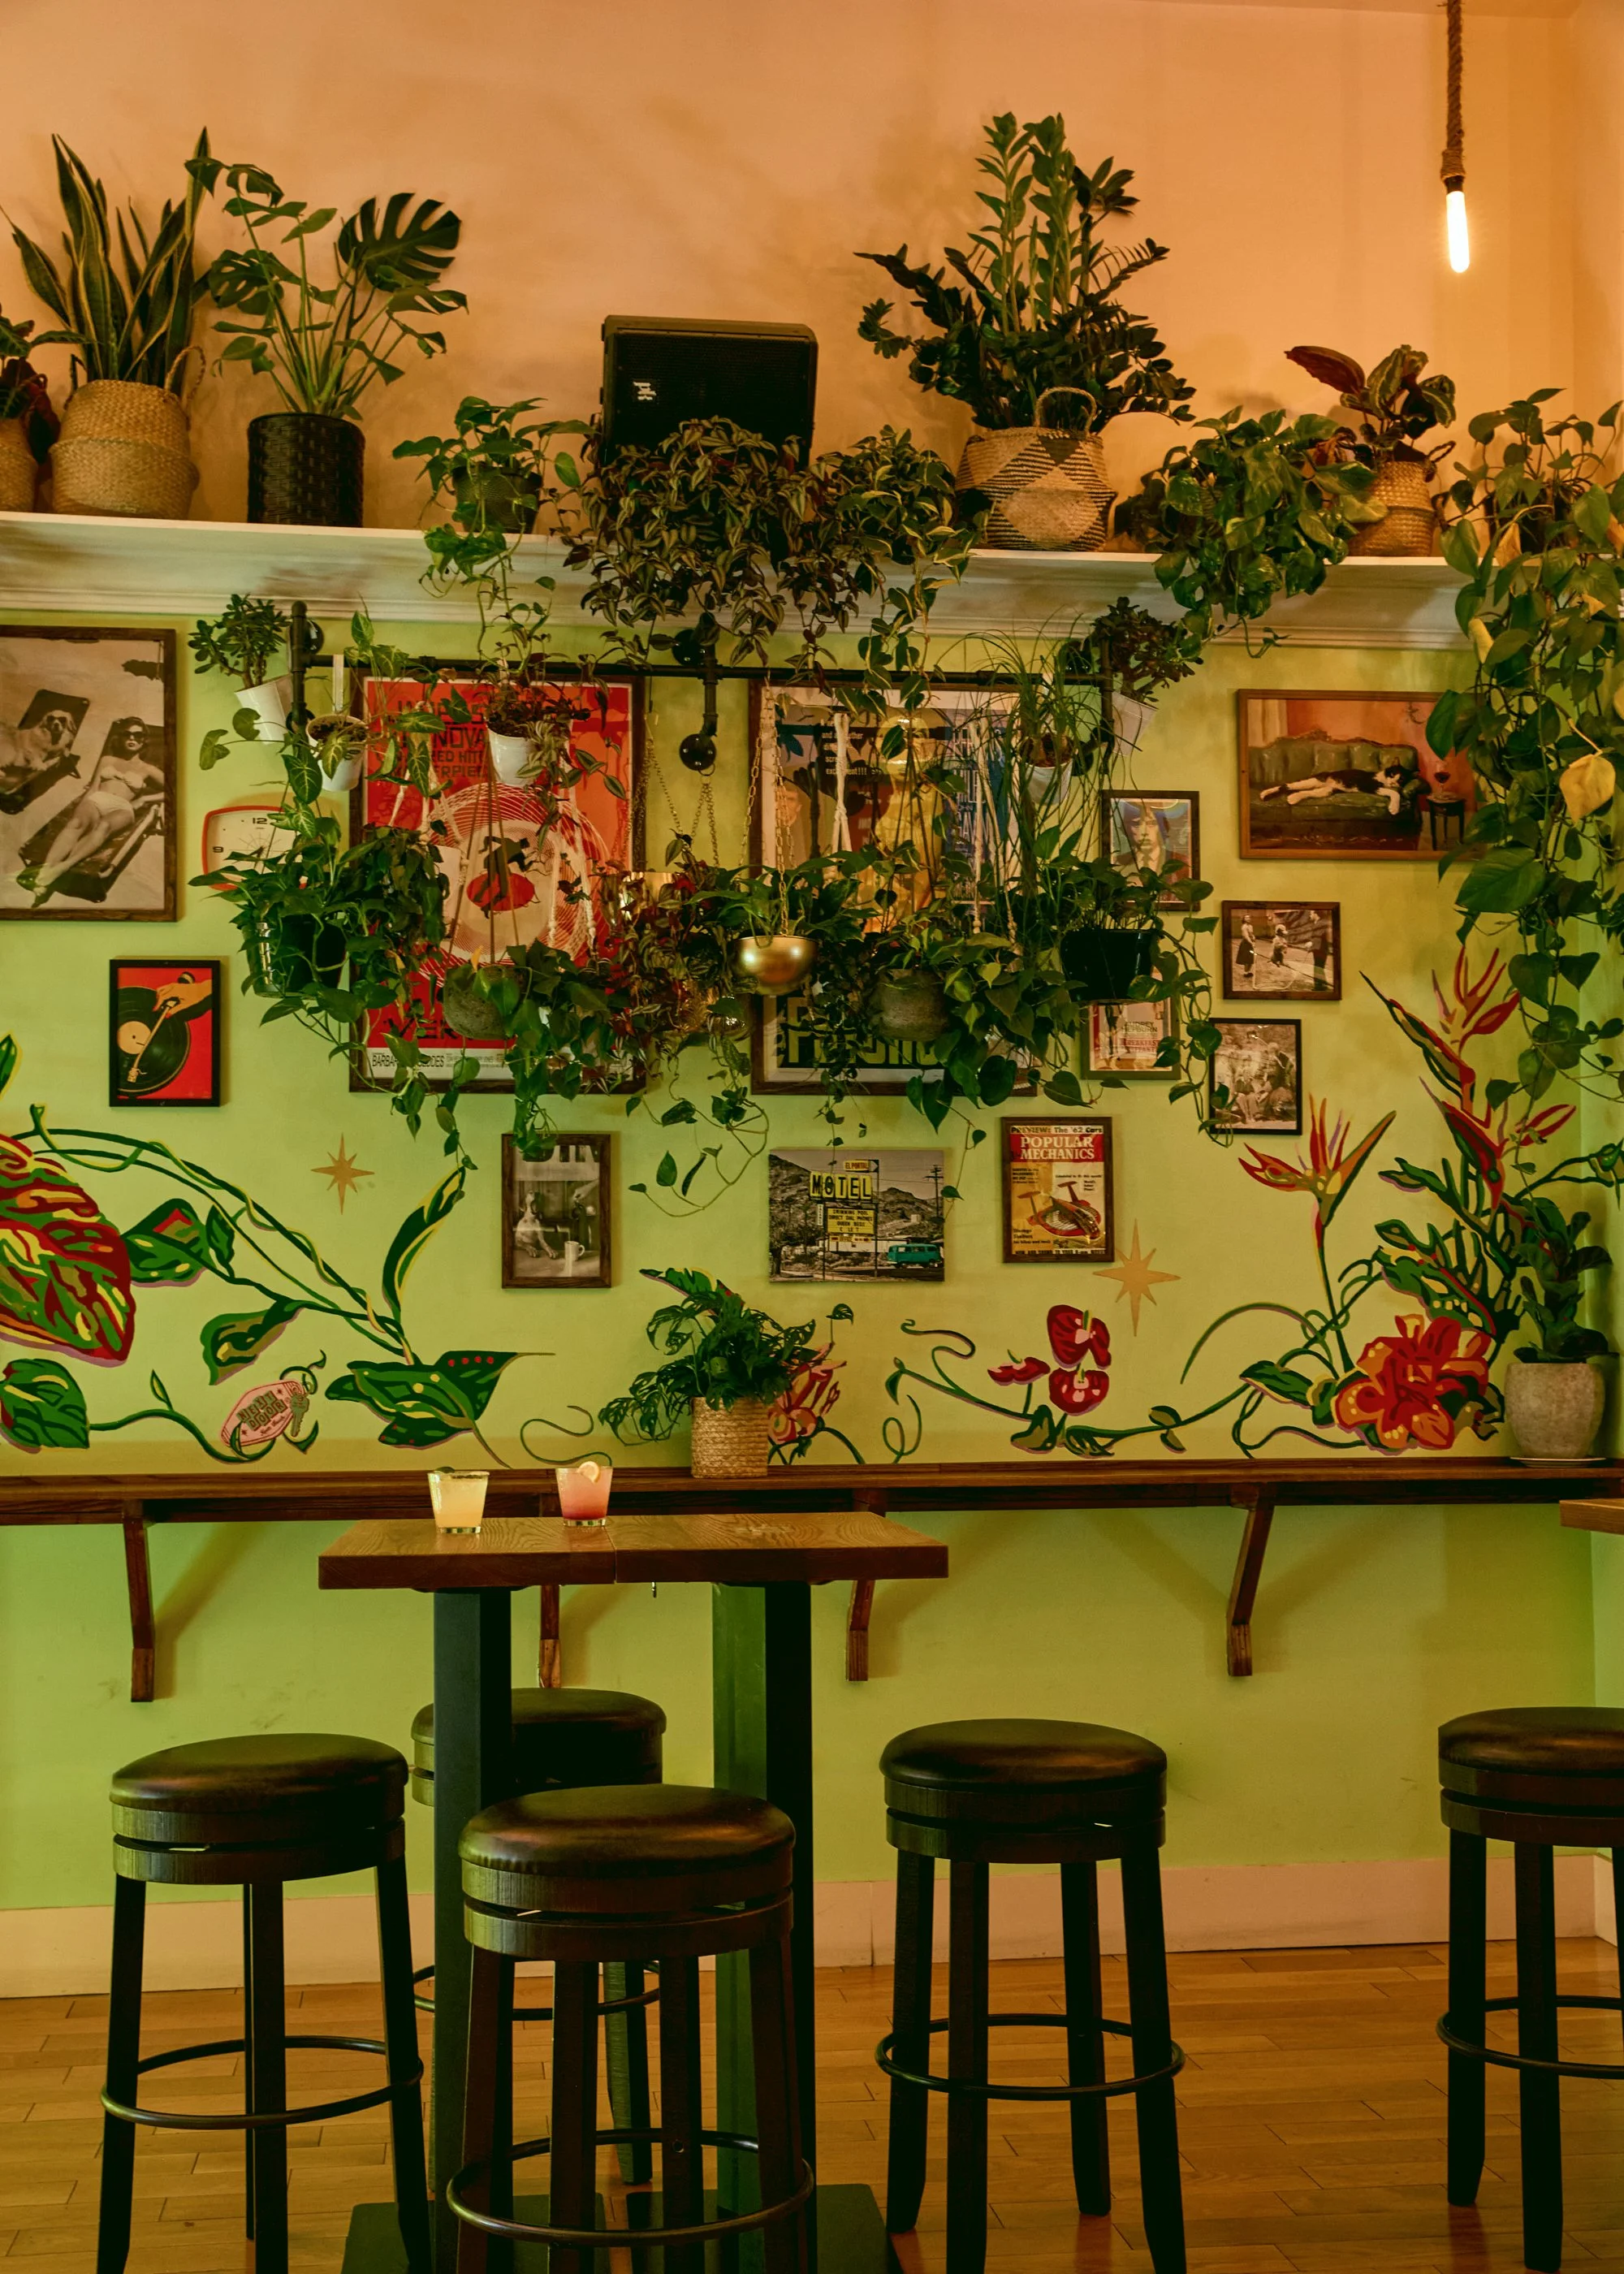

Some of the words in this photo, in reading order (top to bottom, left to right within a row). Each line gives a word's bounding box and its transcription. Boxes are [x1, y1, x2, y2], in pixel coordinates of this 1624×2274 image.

[431, 727, 486, 749] NOVA
[252, 817, 268, 825] 12
[212, 845, 224, 854] 9
[1020, 1136, 1095, 1148] POPULAR
[1019, 1148, 1095, 1160] MECHANICS
[812, 1174, 871, 1197] MOTEL
[237, 1391, 275, 1421] NEXT
[248, 1401, 286, 1429] DOOR
